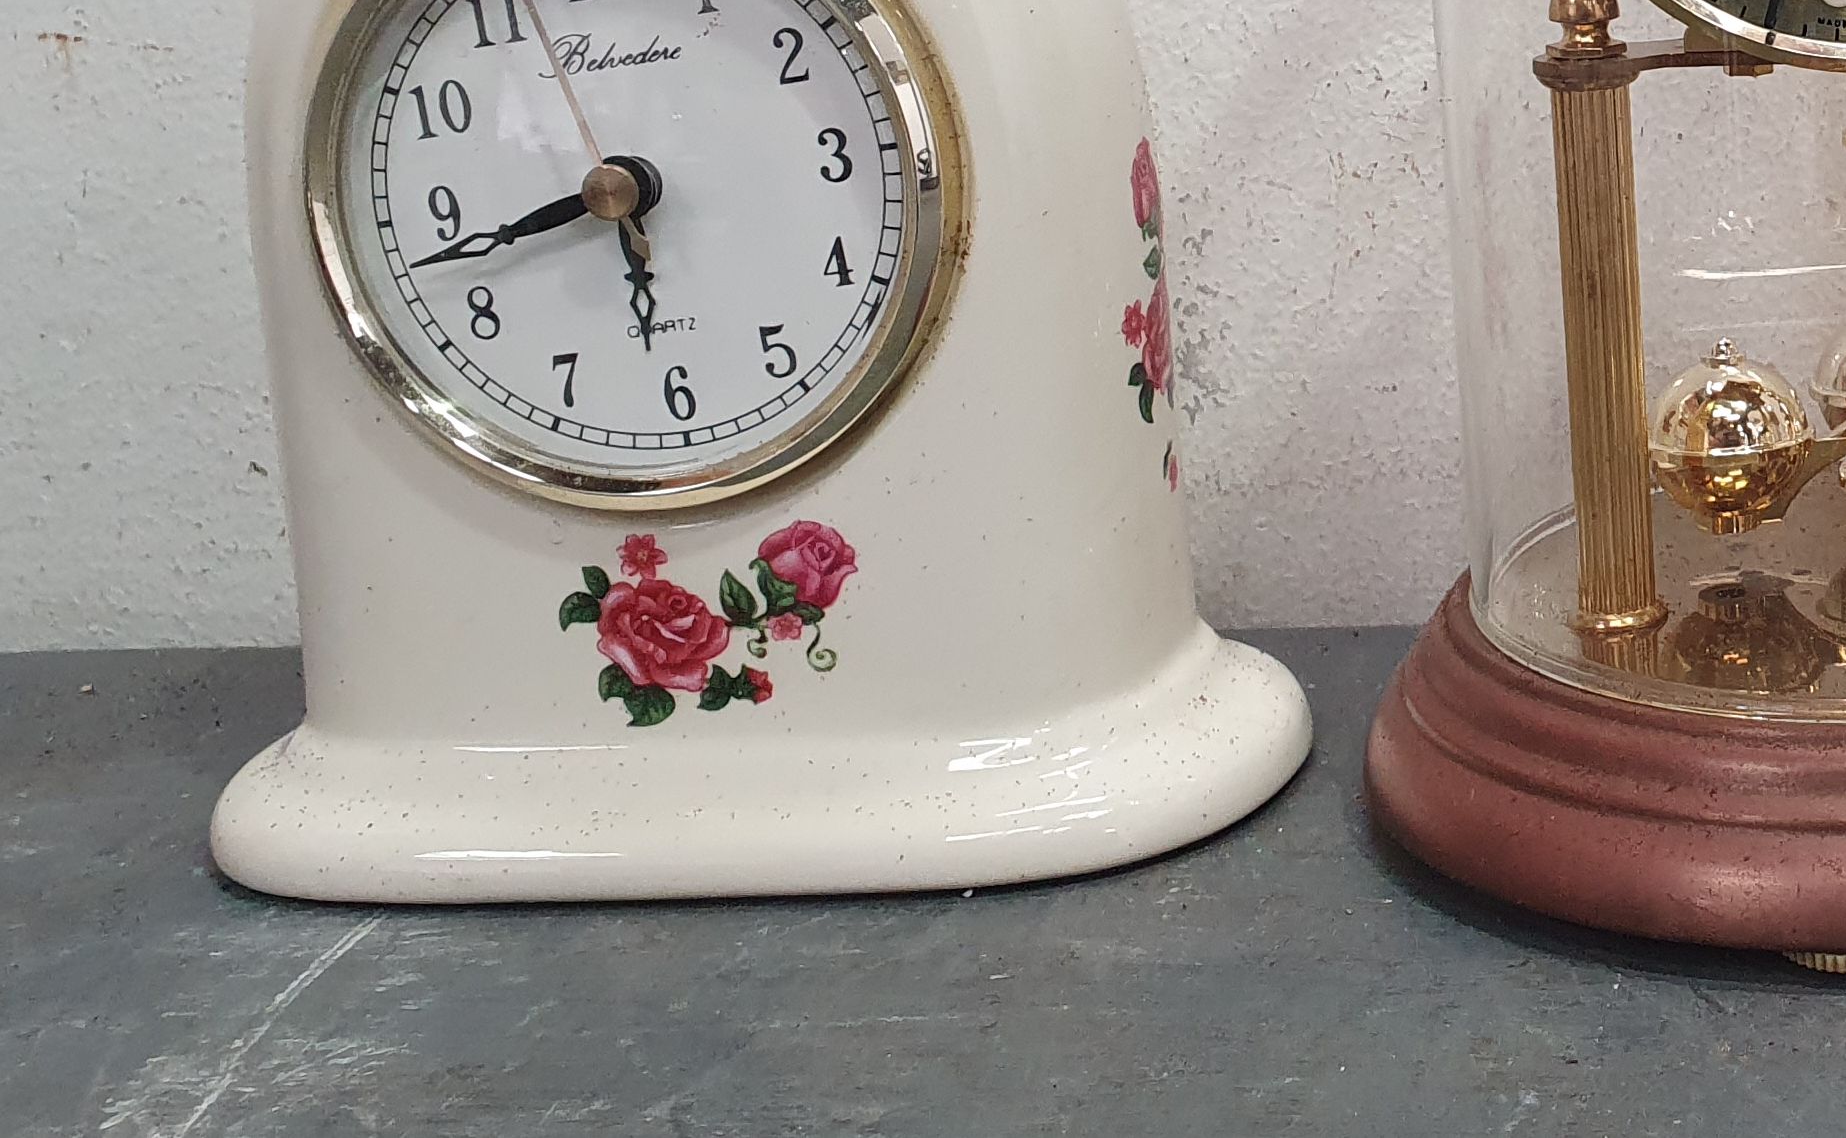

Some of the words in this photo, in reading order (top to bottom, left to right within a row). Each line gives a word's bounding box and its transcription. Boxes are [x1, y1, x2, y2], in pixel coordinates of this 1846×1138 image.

[538, 33, 682, 78] Belvedere
[772, 28, 809, 85] 2
[409, 80, 472, 138] 10
[818, 127, 853, 183] 3
[429, 185, 462, 241] 9
[824, 236, 854, 286] 4
[467, 286, 500, 339] 8
[627, 317, 696, 339] QARTZ
[759, 326, 797, 378] 5
[552, 353, 578, 407] 7
[664, 366, 697, 421] 6
